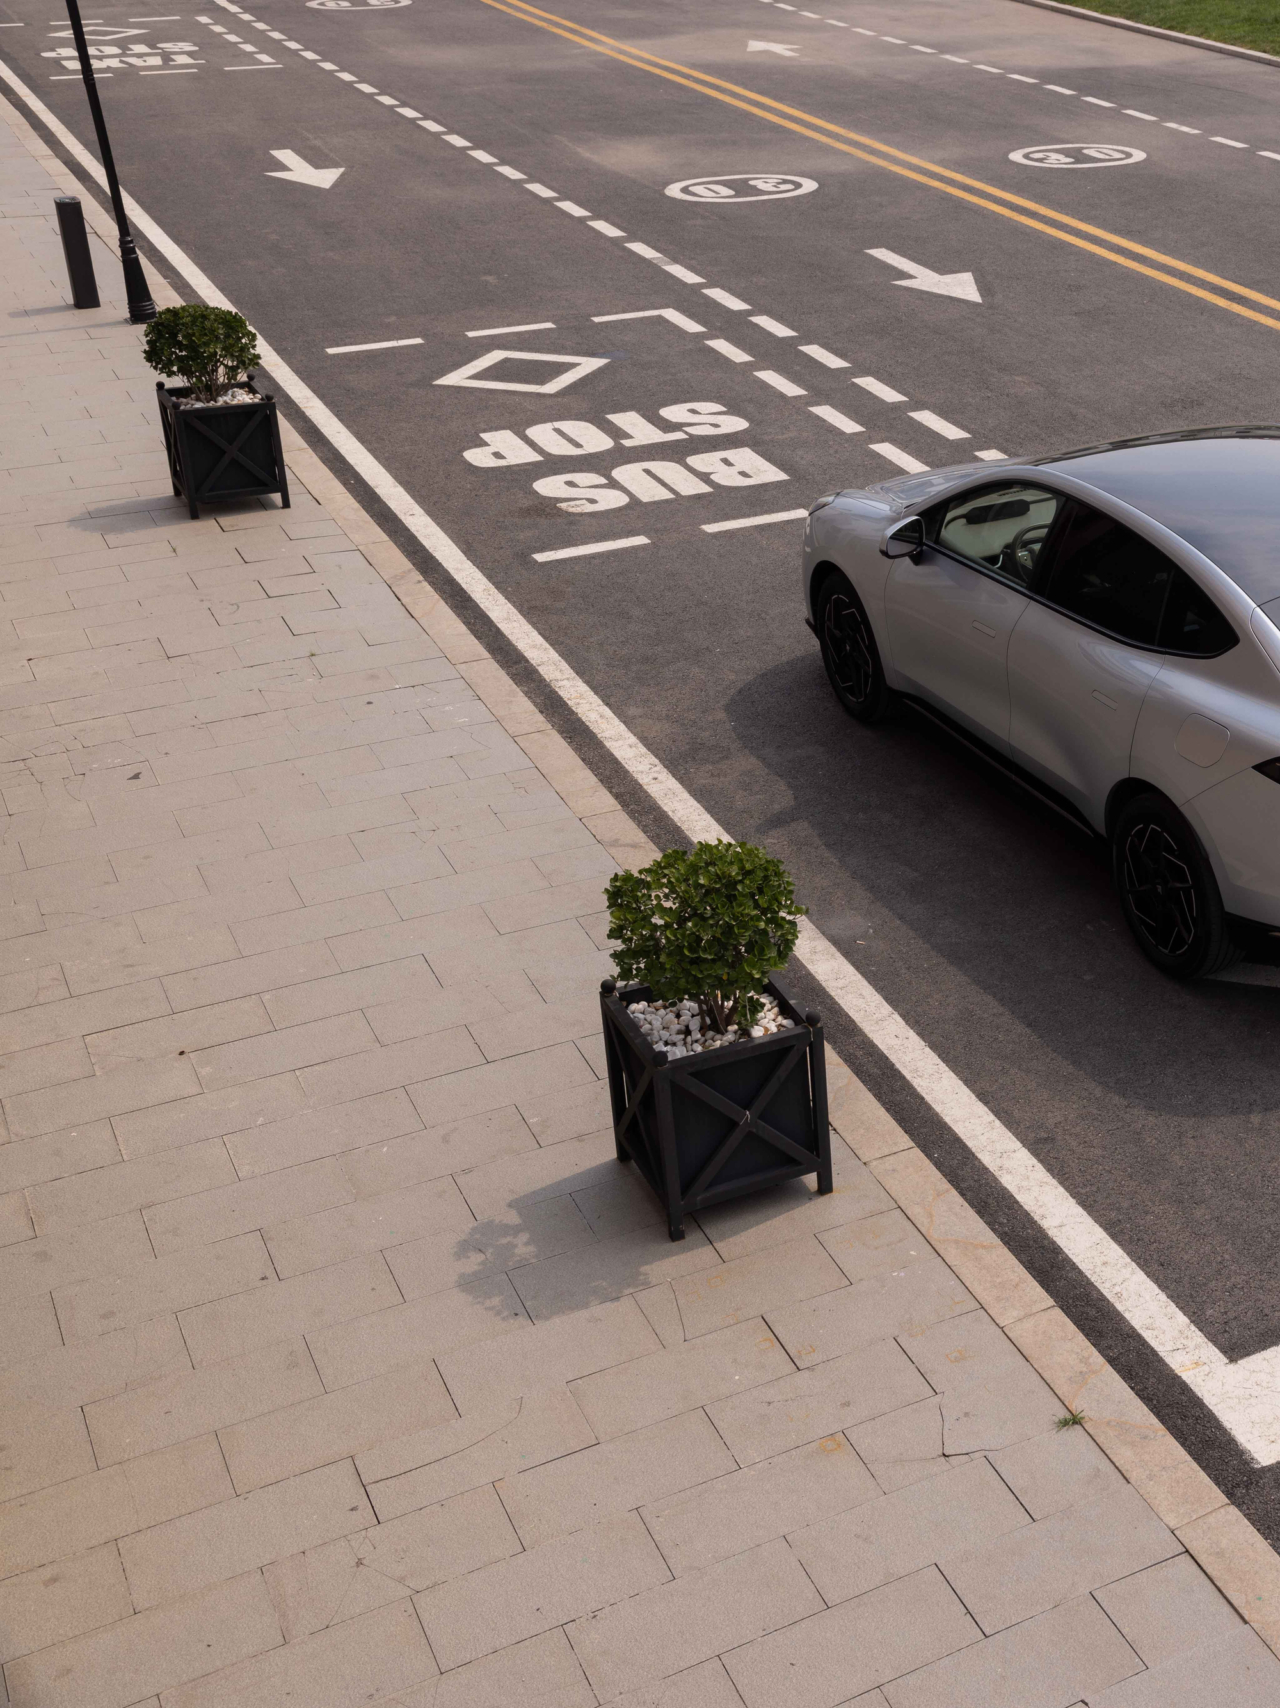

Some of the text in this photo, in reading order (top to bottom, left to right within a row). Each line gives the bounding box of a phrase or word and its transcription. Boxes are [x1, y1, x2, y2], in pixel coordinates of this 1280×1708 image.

[40, 42, 199, 58] STOP
[1029, 148, 1126, 164] 30
[689, 179, 795, 198] 30
[463, 402, 750, 467] STOP
[533, 447, 791, 513] BUS
